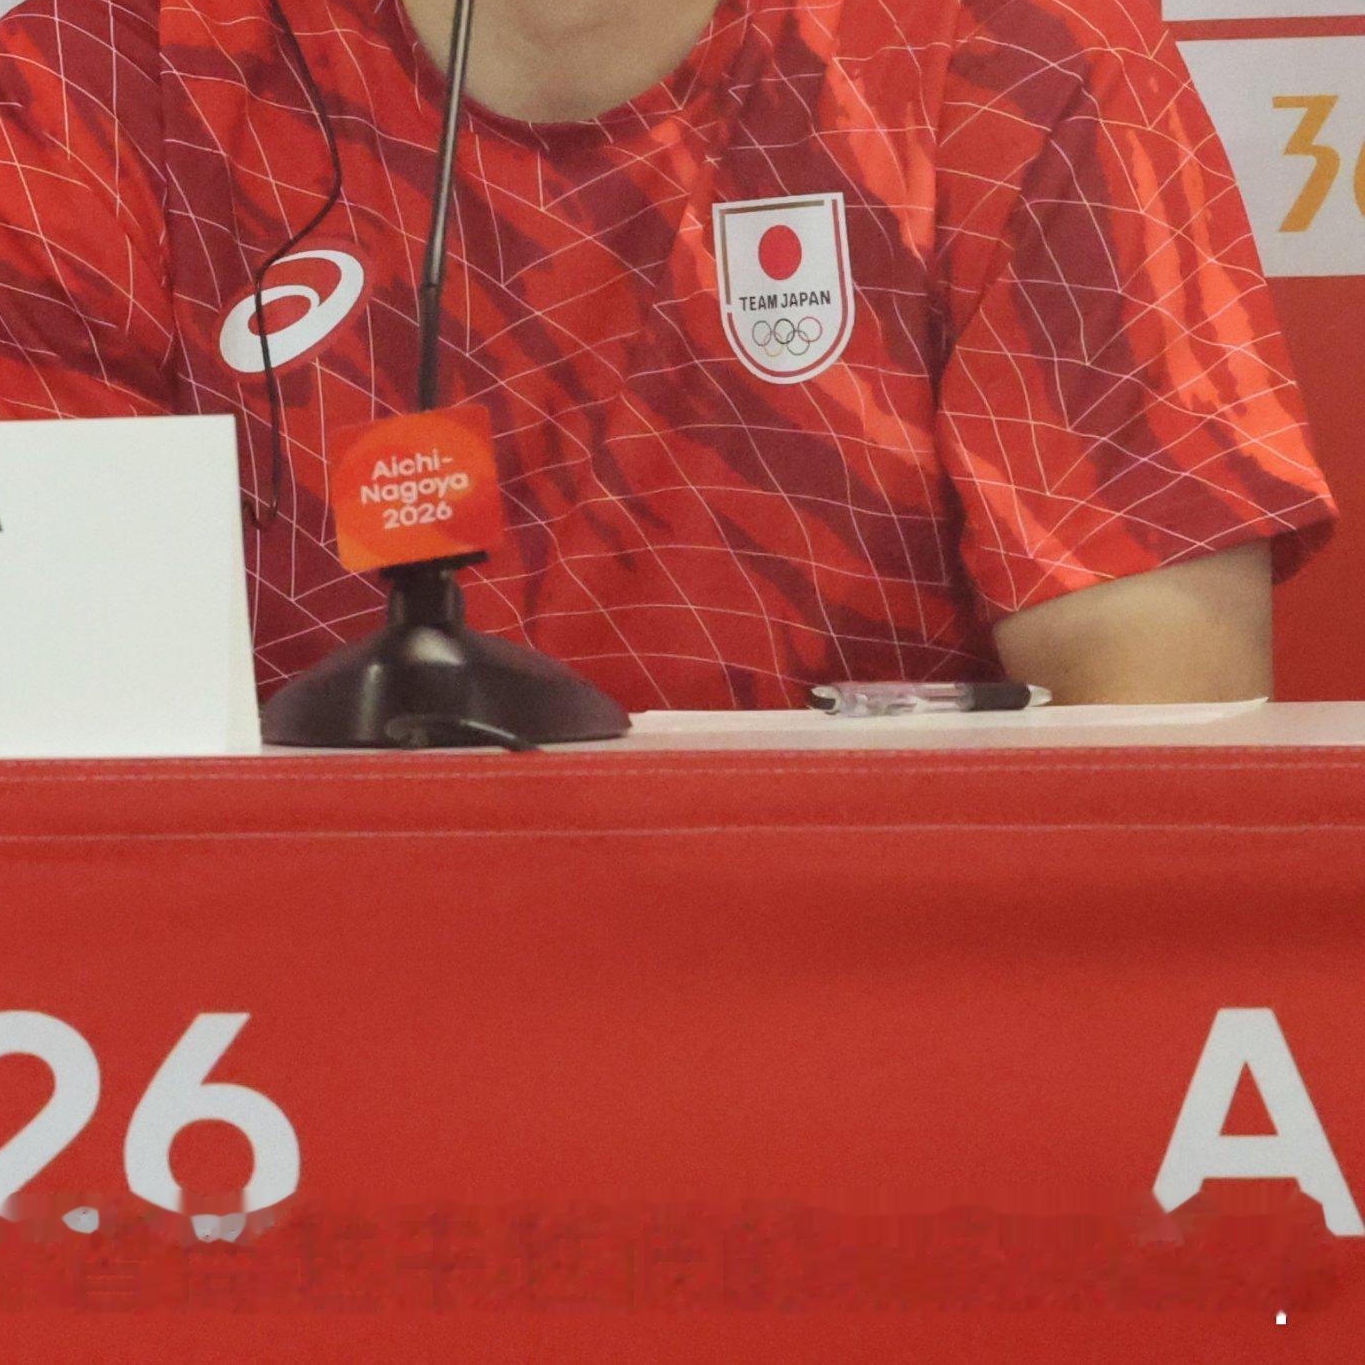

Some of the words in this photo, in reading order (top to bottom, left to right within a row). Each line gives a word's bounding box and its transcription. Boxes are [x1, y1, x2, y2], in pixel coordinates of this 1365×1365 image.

[1272, 95, 1365, 233] 3
[739, 294, 778, 312] TEAM
[780, 290, 831, 309] JAPAN
[371, 448, 453, 480] Aichi-
[359, 472, 469, 505] Nagoya
[382, 502, 453, 529] 2026
